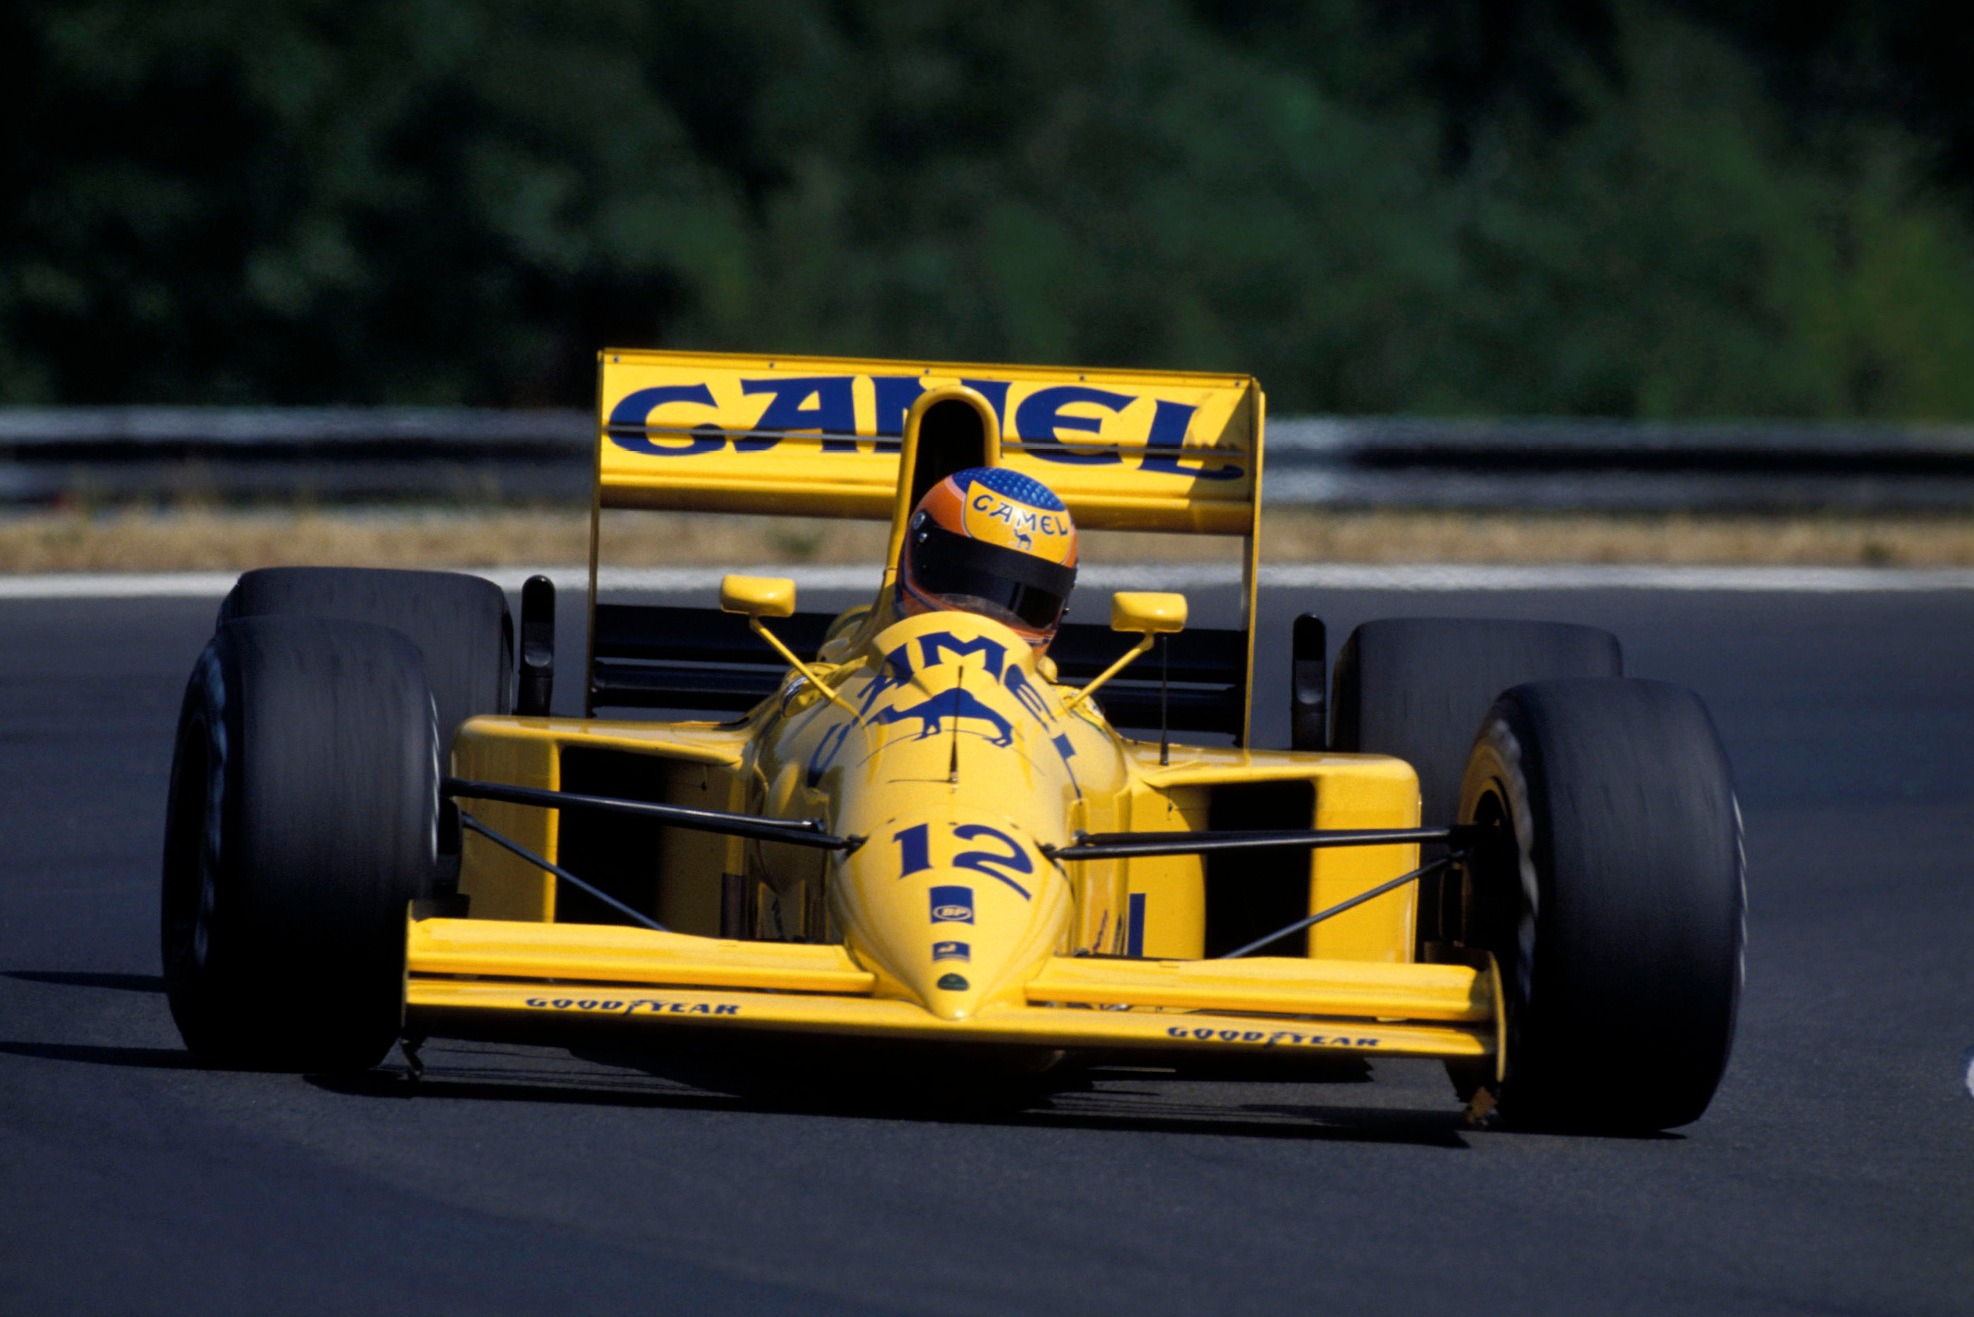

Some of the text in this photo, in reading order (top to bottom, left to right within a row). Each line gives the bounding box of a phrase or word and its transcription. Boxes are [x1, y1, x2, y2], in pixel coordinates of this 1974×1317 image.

[972, 494, 1068, 536] CAMEL
[805, 631, 1083, 800] CAMEL
[893, 823, 1034, 900] 12
[525, 998, 740, 1016] GOODYEAR
[1167, 1026, 1380, 1047] GOODYEAR
